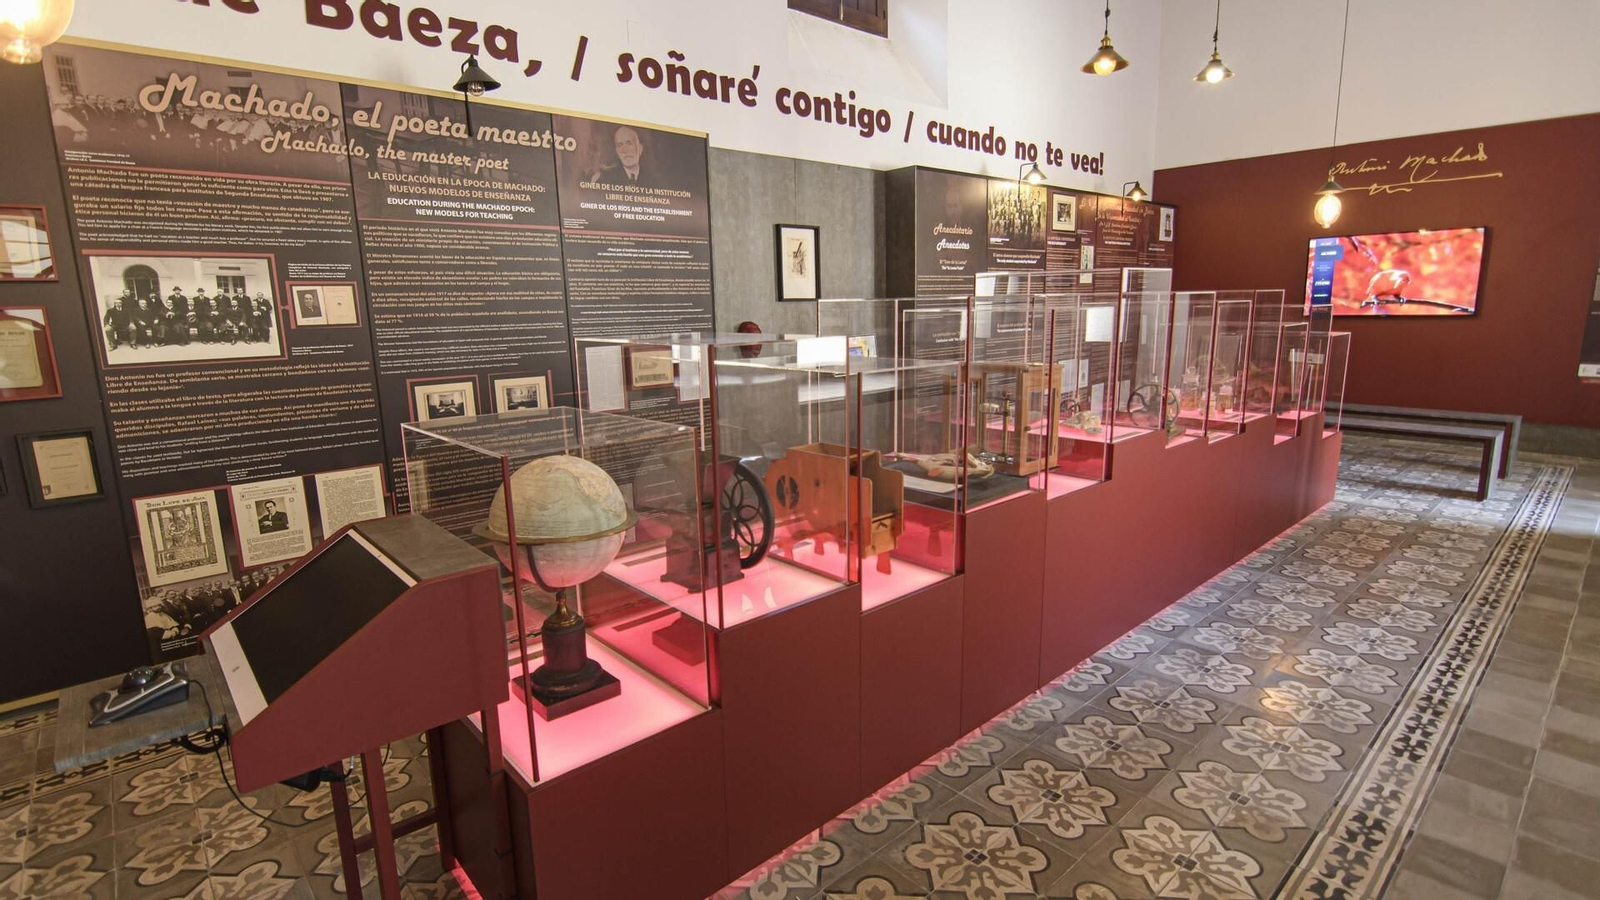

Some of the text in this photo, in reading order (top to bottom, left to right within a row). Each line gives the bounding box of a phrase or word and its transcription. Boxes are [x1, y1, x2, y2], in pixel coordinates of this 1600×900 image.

[306, 0, 1105, 176] Baeza, / soñaré contigo / cuando no te vea!
[139, 72, 577, 152] Machado, el poeta maestro
[260, 130, 509, 175] Machado, the master poet
[368, 171, 546, 193] LA EDUCACIÓN EN LA ÉPOCA DE MACHADO:
[390, 184, 531, 201] NUEVOS MODELOS DE ENSEÑANZA
[580, 182, 600, 190] GINER
[625, 185, 639, 193] RÍOS
[654, 189, 691, 198] INSTITUCIÓN
[387, 198, 431, 207] EDUCATION
[432, 200, 460, 209] DURING
[476, 203, 510, 211] MACHADO
[606, 193, 623, 201] LIBRE
[634, 196, 670, 204] ENSEÑANZA
[480, 212, 513, 220] TEACHING
[654, 208, 692, 216] ESTABLISHMENT
[933, 223, 973, 235] Anecdotario
[937, 238, 970, 251] Anecdotes
